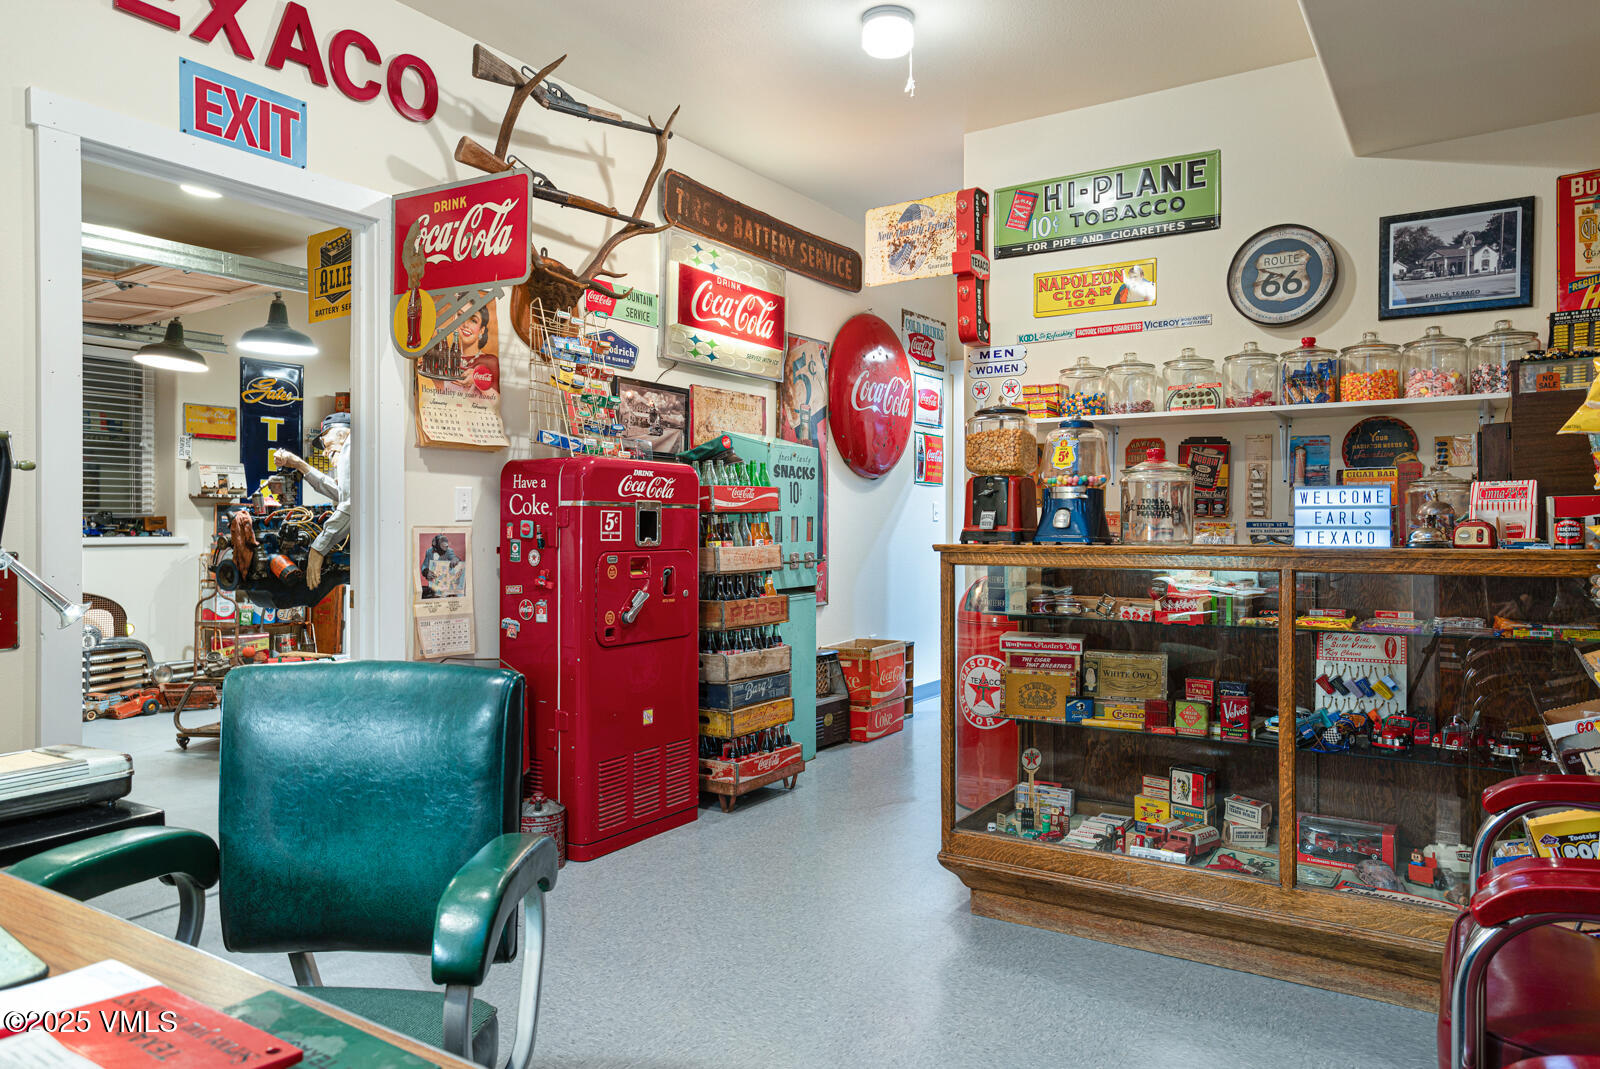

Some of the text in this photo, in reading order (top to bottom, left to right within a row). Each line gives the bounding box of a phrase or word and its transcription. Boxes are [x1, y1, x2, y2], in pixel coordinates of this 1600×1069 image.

[113, 0, 440, 122] XACO
[193, 75, 302, 160] EXIT
[1043, 158, 1208, 213] HI-PLANE
[1570, 176, 1600, 199] BU
[433, 196, 468, 215] DRINK
[1069, 196, 1186, 228] TOBACCO
[413, 197, 520, 266] Coca-Cola
[1031, 215, 1060, 240] 10¢
[1027, 221, 1186, 252] FOR PIPE AND CIGARETTES
[733, 214, 796, 257] BATTERY
[799, 243, 853, 281] SERVICE
[928, 262, 953, 270] Guarante
[971, 256, 990, 273] TEXACO
[1263, 253, 1300, 267] ROUTE
[716, 277, 742, 292] DRINK
[1038, 268, 1126, 293] NAPOLEON
[1260, 269, 1303, 297] 66
[1572, 273, 1600, 292] REGUL
[1052, 286, 1112, 302] CIGAR
[1451, 289, 1481, 297] TEXACO
[315, 305, 341, 318] BATTERY
[625, 306, 651, 322] SERVICE
[690, 280, 778, 340] Coca-Cola
[905, 317, 944, 341] COLD DRINKS
[1112, 323, 1142, 333] CIGARETTES
[1144, 319, 1180, 331] VICEROY
[1018, 333, 1039, 343] KOOL
[607, 344, 635, 358] odrich
[979, 348, 1015, 361] MEN
[975, 363, 1019, 375] WOMEN
[1542, 373, 1554, 382] NO
[241, 377, 304, 404] Gates
[421, 384, 456, 399] Hospitality
[479, 391, 496, 401] hands
[1538, 381, 1559, 390] SALE
[850, 369, 911, 419] Coca-Cola
[1368, 431, 1389, 442] YOUR
[778, 453, 812, 466] fresh tasty
[1058, 450, 1070, 463] 5¢
[633, 469, 655, 478] DRINK
[772, 463, 816, 481] SNACKS
[1345, 470, 1396, 479] CIGAR BAR
[512, 474, 547, 489] Have a
[1299, 489, 1384, 505] WELCOME
[509, 493, 553, 517] Coke.
[604, 512, 619, 532] 5¢
[1314, 511, 1372, 525] EARLS
[1304, 530, 1376, 545] TEXACO
[729, 600, 785, 623] PEPSI
[961, 658, 1003, 682] GASOLI
[1040, 662, 1073, 670] BREATHES
[844, 675, 861, 690] ke
[971, 677, 1001, 687] TEXACO
[1103, 670, 1152, 680] WHITE OWL
[744, 678, 773, 701] Barq's
[1188, 688, 1211, 696] LEADER
[1112, 709, 1145, 721] Cremo
[1222, 700, 1249, 723] Velvet
[874, 711, 893, 729] Coke
[1143, 812, 1161, 820] SUPER
[1198, 829, 1217, 843] TEXACO
[1568, 832, 1598, 842] Tootsie
